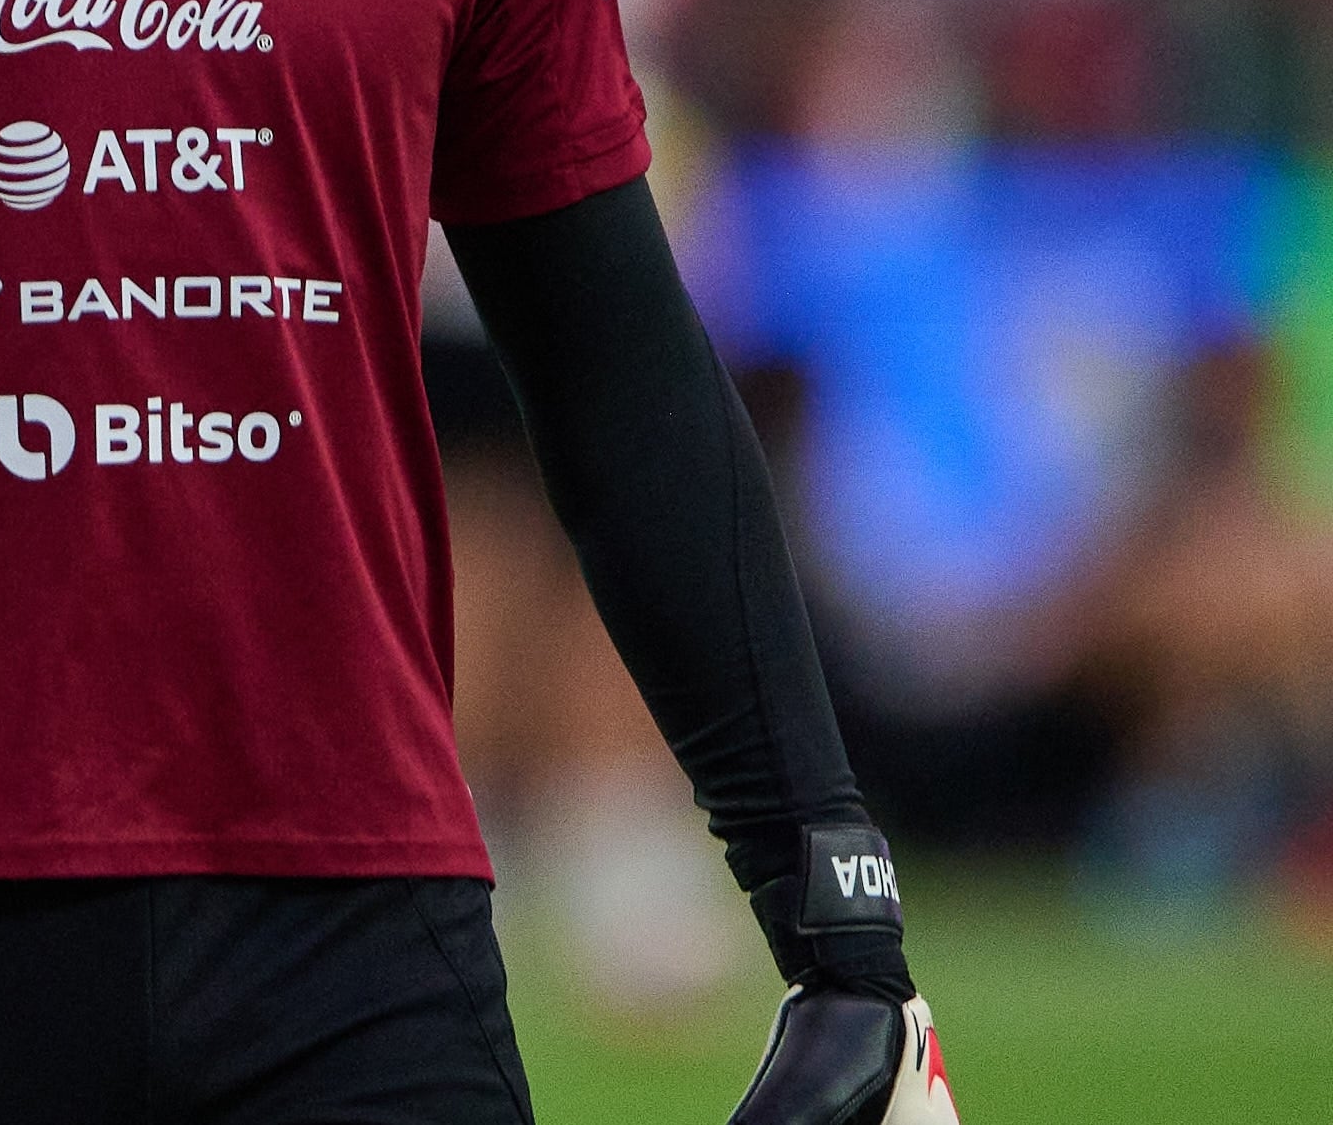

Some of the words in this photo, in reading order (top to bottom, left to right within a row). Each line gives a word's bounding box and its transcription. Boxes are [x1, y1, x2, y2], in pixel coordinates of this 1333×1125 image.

[82, 126, 257, 194] AT&T
[20, 275, 343, 324] BANORTE
[95, 396, 282, 465] Bitso
[830, 854, 901, 905] HOA
